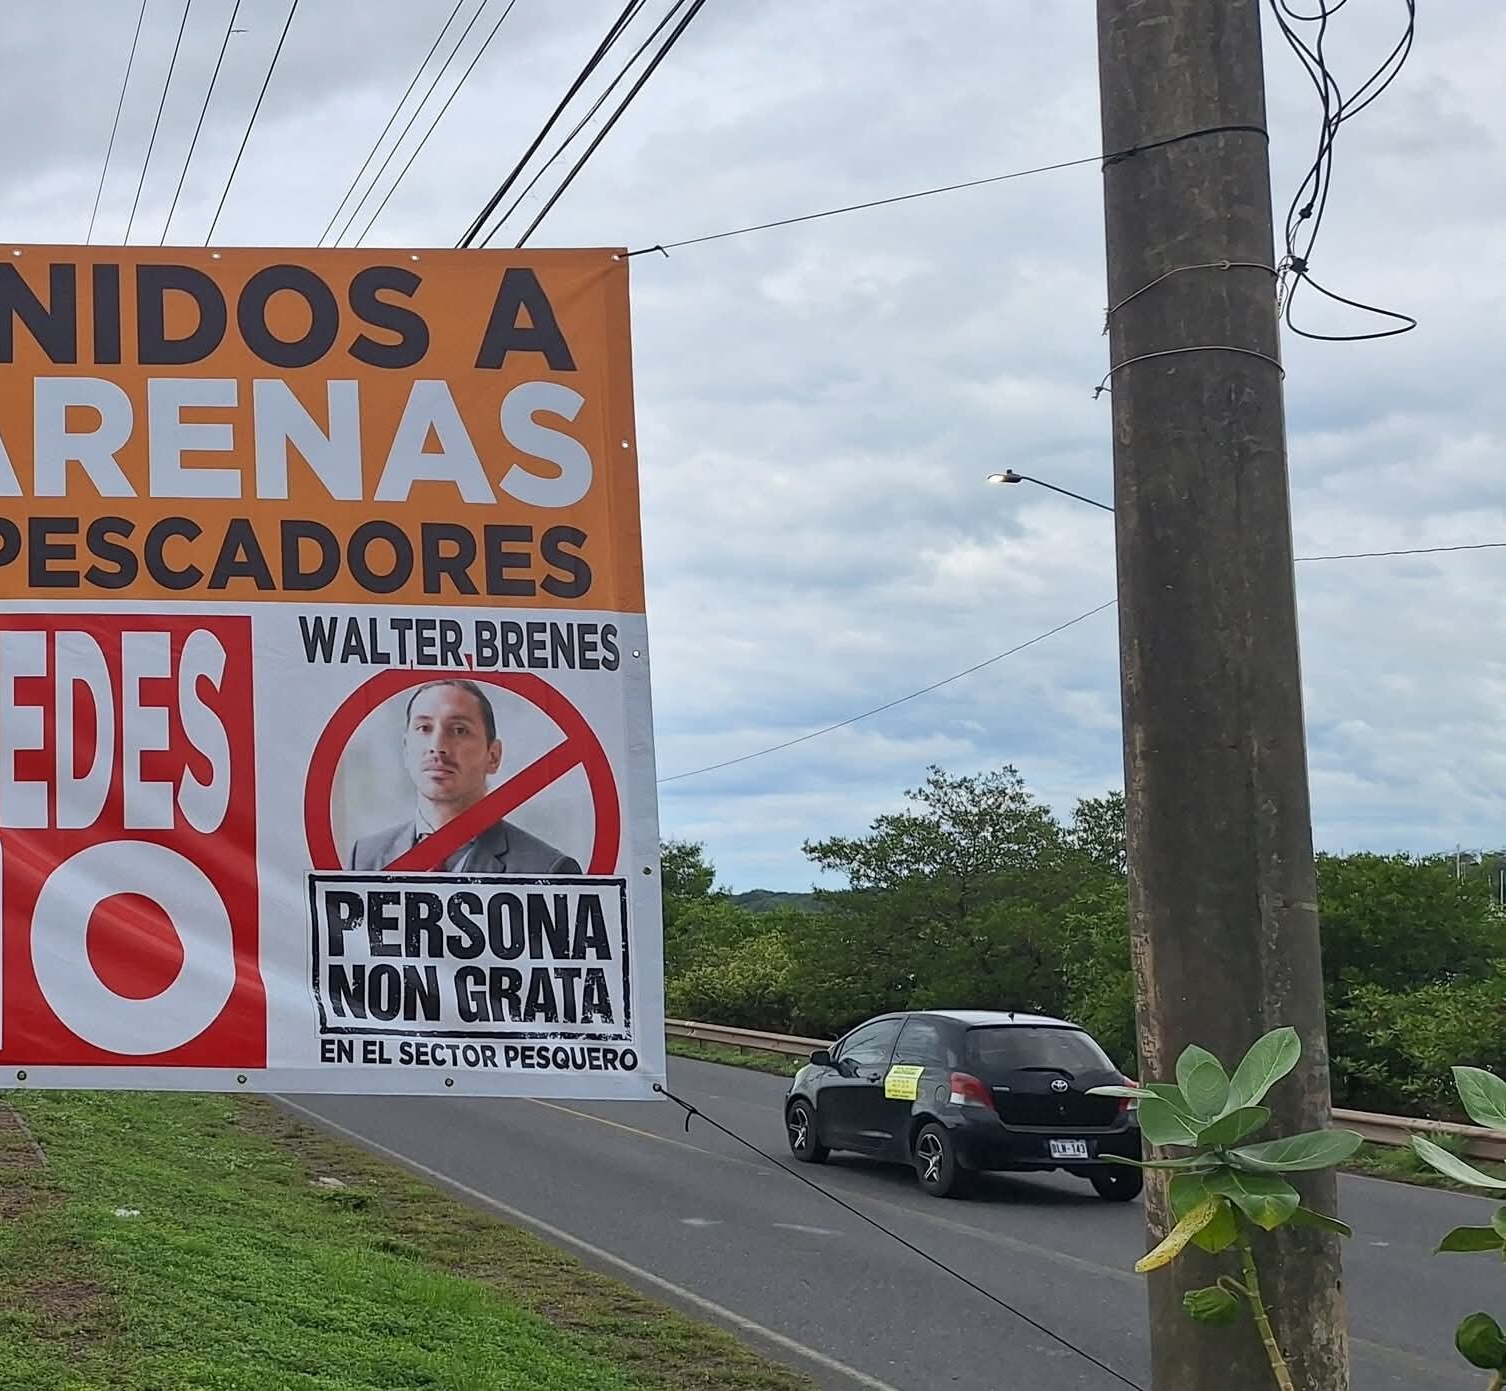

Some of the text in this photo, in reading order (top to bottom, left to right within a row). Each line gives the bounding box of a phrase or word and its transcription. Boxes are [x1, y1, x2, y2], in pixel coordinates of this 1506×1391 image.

[475, 268, 577, 371] A
[298, 616, 620, 671] WALTER BRENES
[324, 890, 613, 962] PERSONA
[326, 964, 615, 1026] NON GRATA
[320, 1040, 639, 1072] EN EL SECTOR PESQUERO
